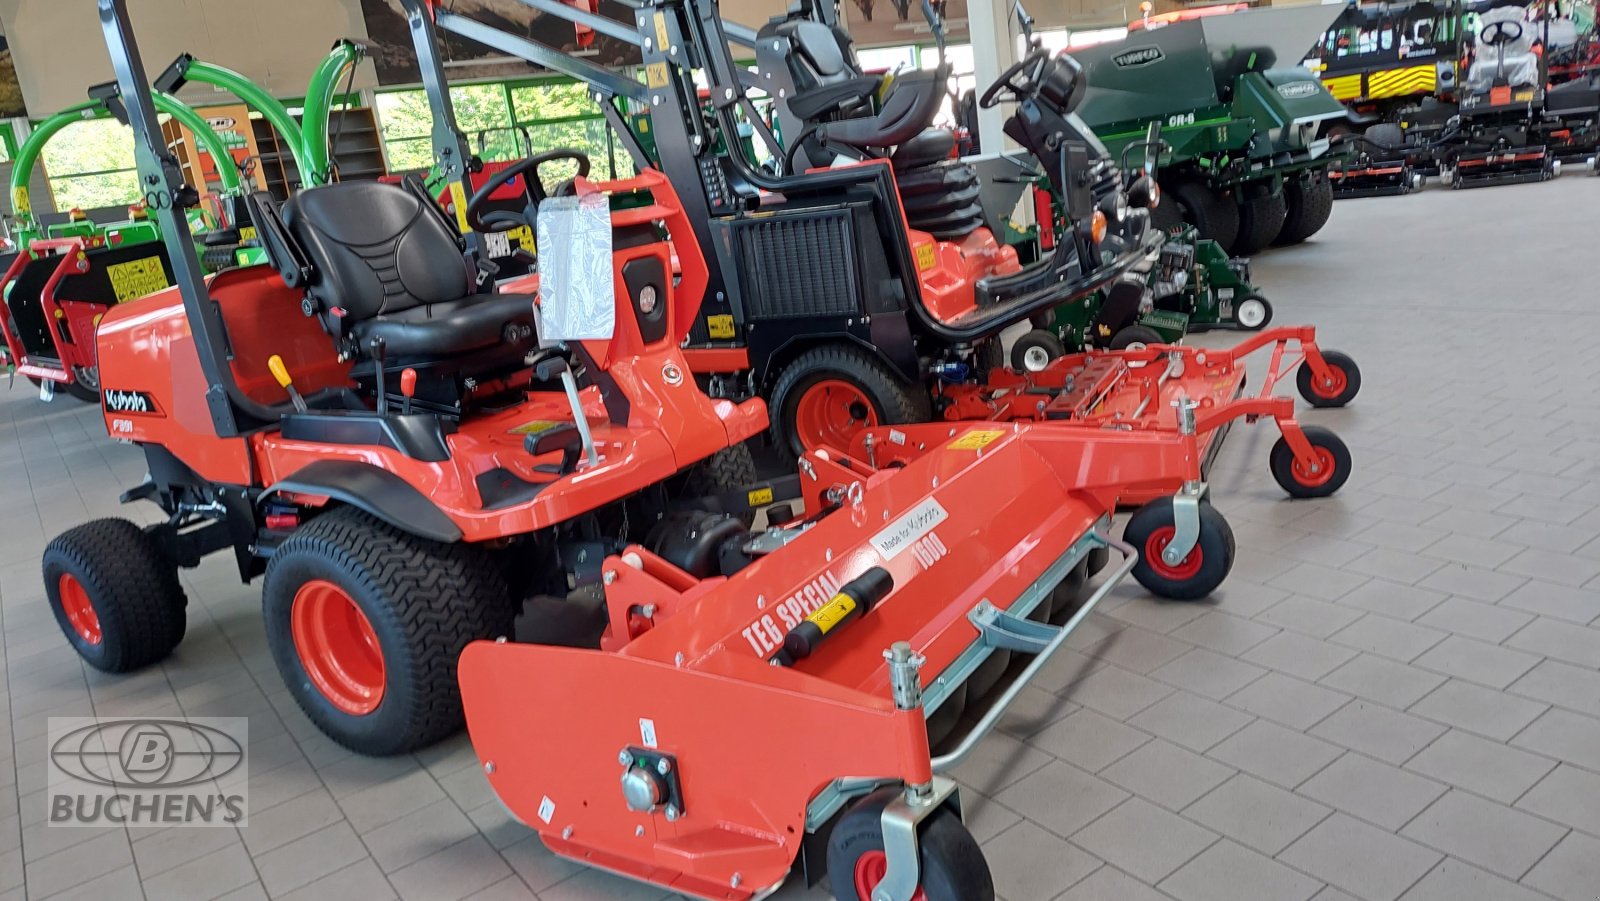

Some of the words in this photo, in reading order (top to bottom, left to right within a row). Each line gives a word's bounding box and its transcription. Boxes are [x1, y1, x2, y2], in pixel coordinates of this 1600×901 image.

[105, 389, 147, 412] Kubota
[880, 535, 902, 552] Made
[914, 531, 947, 570] 1600
[742, 614, 784, 658] TEG
[776, 569, 841, 631] SPECIAL
